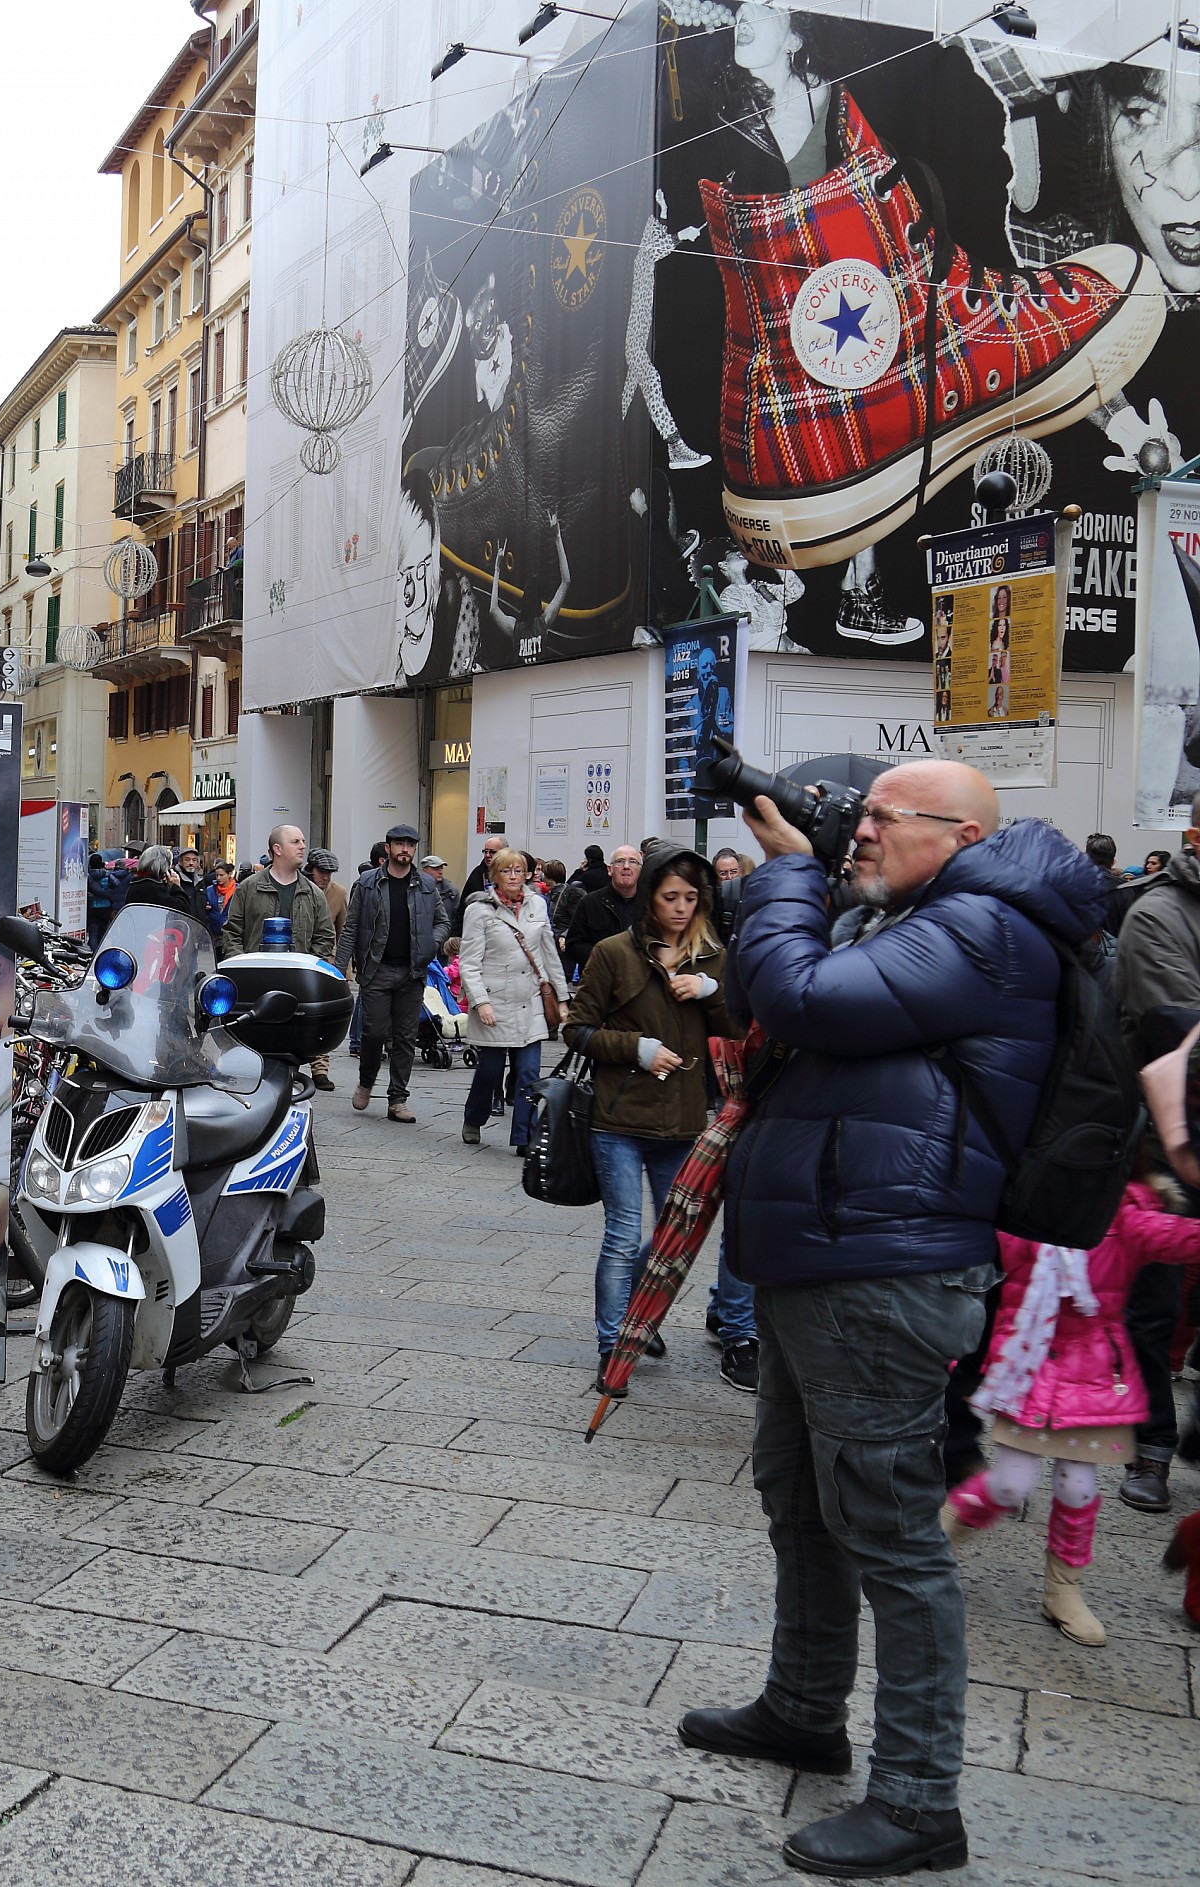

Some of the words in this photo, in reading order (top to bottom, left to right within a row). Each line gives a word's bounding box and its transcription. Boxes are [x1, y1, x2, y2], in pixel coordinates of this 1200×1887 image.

[559, 195, 604, 236] CONVERSE
[554, 278, 568, 303] ALL
[571, 272, 596, 306] STAR
[805, 273, 878, 321] CONVERSE
[819, 357, 847, 376] ALL
[853, 337, 886, 374] STAR
[1073, 511, 1135, 544] BORING
[1170, 508, 1181, 520] 29
[752, 537, 788, 565] STAR
[935, 538, 1010, 567] Divertiamoci
[935, 571, 942, 584] a
[1068, 546, 1138, 599] EAKE
[518, 634, 542, 657] PARTY
[672, 640, 700, 653] VERONA
[672, 651, 691, 663] JAZZ
[672, 658, 699, 672] WINTER
[672, 669, 690, 682] 2015
[876, 723, 933, 753] MA
[192, 775, 201, 799] la
[202, 772, 232, 798] batida
[270, 1140, 291, 1159] POLIZIA
[286, 1122, 301, 1143] LOCALE
